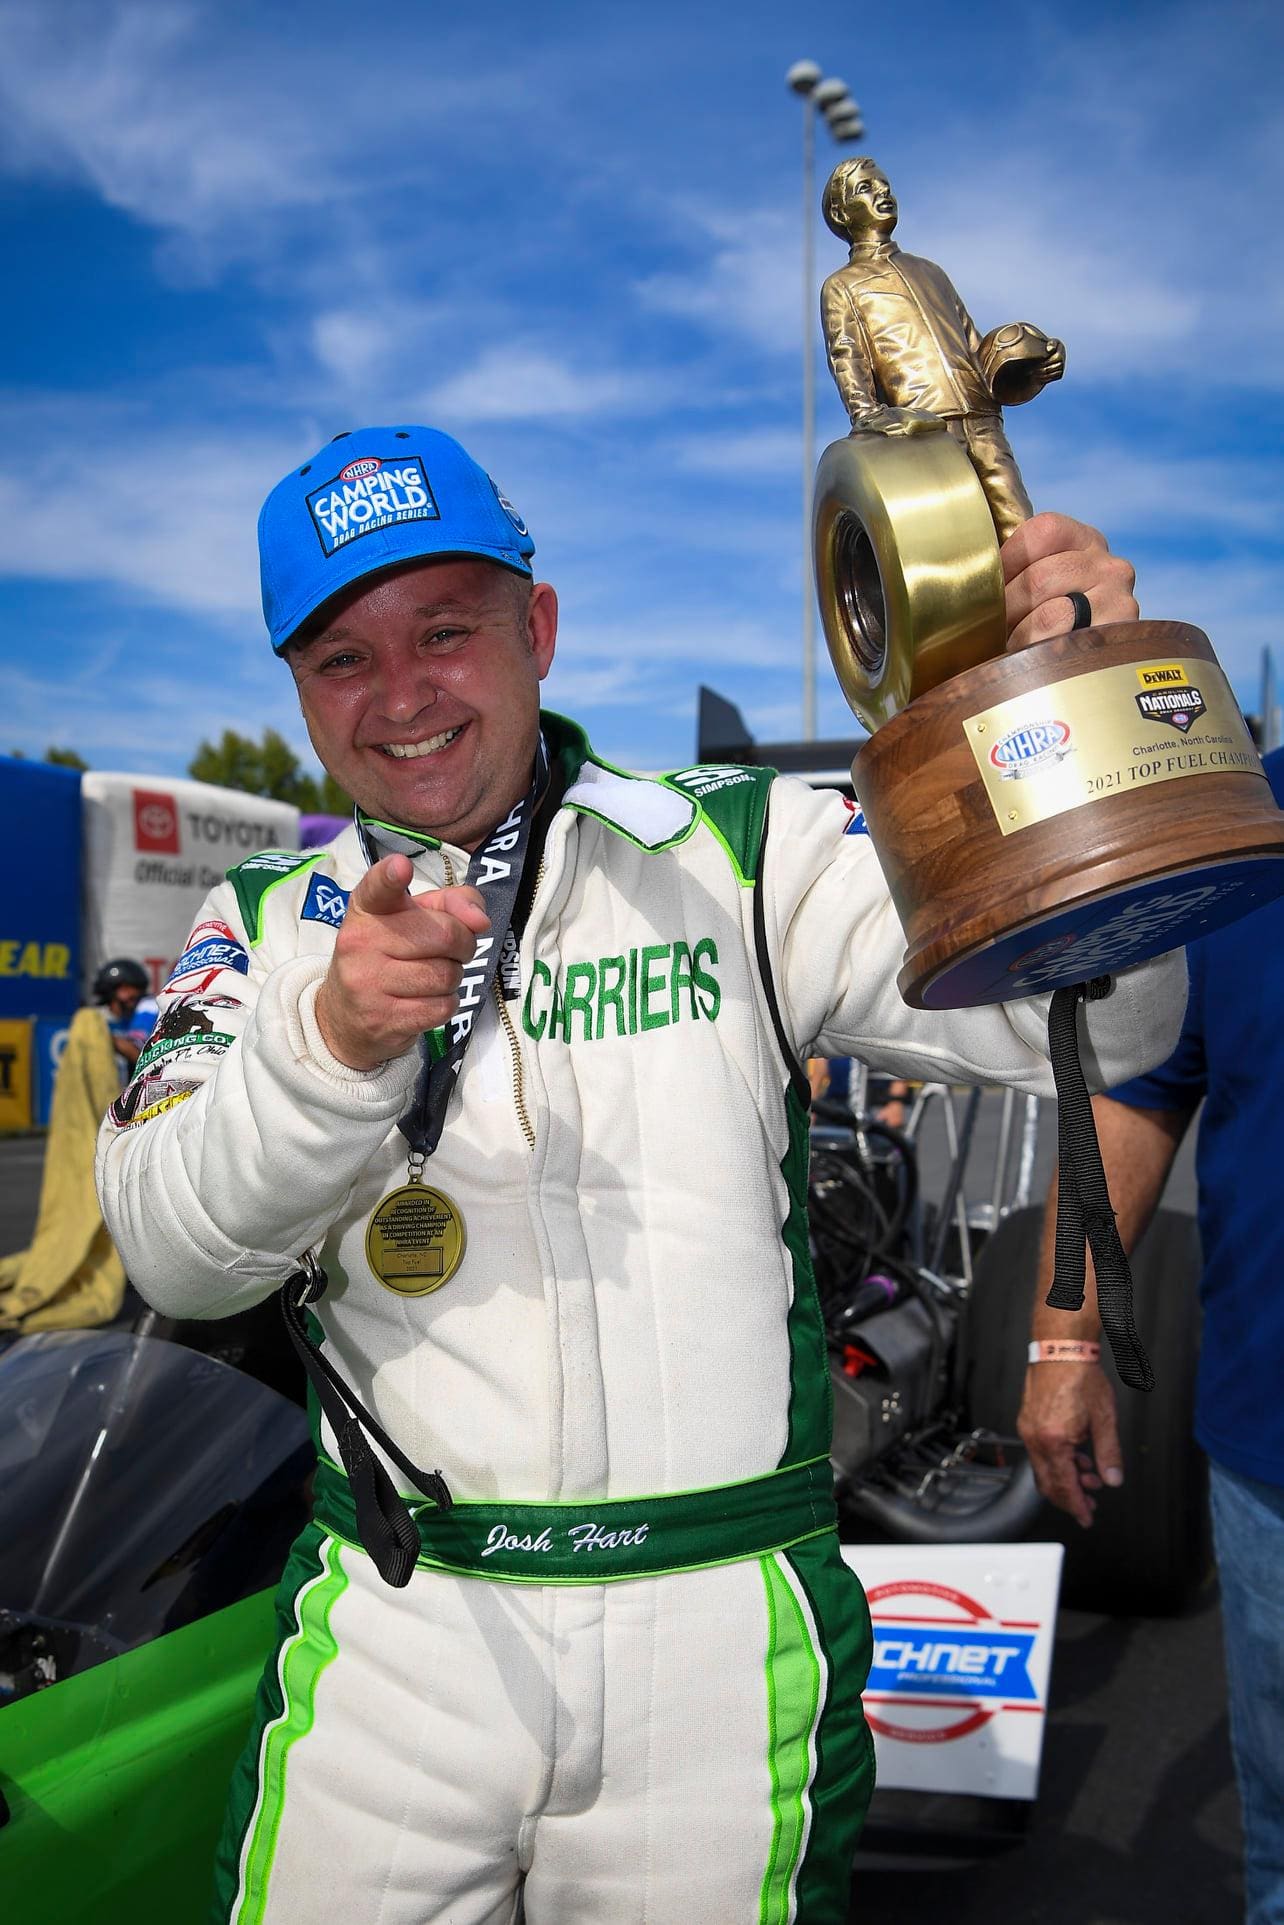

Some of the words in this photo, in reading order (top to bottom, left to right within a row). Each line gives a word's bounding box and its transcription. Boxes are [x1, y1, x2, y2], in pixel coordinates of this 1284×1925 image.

[345, 462, 376, 478] NHRA
[314, 467, 422, 517] CAMPING
[320, 485, 428, 538] WORLD
[333, 528, 356, 548] DRAG
[359, 514, 393, 534] RACING
[396, 507, 428, 521] SERIES
[1139, 690, 1202, 711] NATIONALS
[1002, 726, 1059, 761] NHRA
[1132, 740, 1180, 756] Charlotte,
[1180, 736, 1204, 748] North
[1204, 734, 1234, 745] Carolina
[693, 773, 750, 798] SIMPSON
[1087, 771, 1121, 794] 2021
[1128, 760, 1163, 781] TOP
[1166, 753, 1208, 772] FUEL
[187, 813, 278, 848] TOYOTA
[476, 800, 524, 886] HRA
[1046, 885, 1217, 979] WORLD
[523, 937, 722, 1044] CARRIERS
[480, 1524, 554, 1558] Josh
[567, 1522, 650, 1553] Hart
